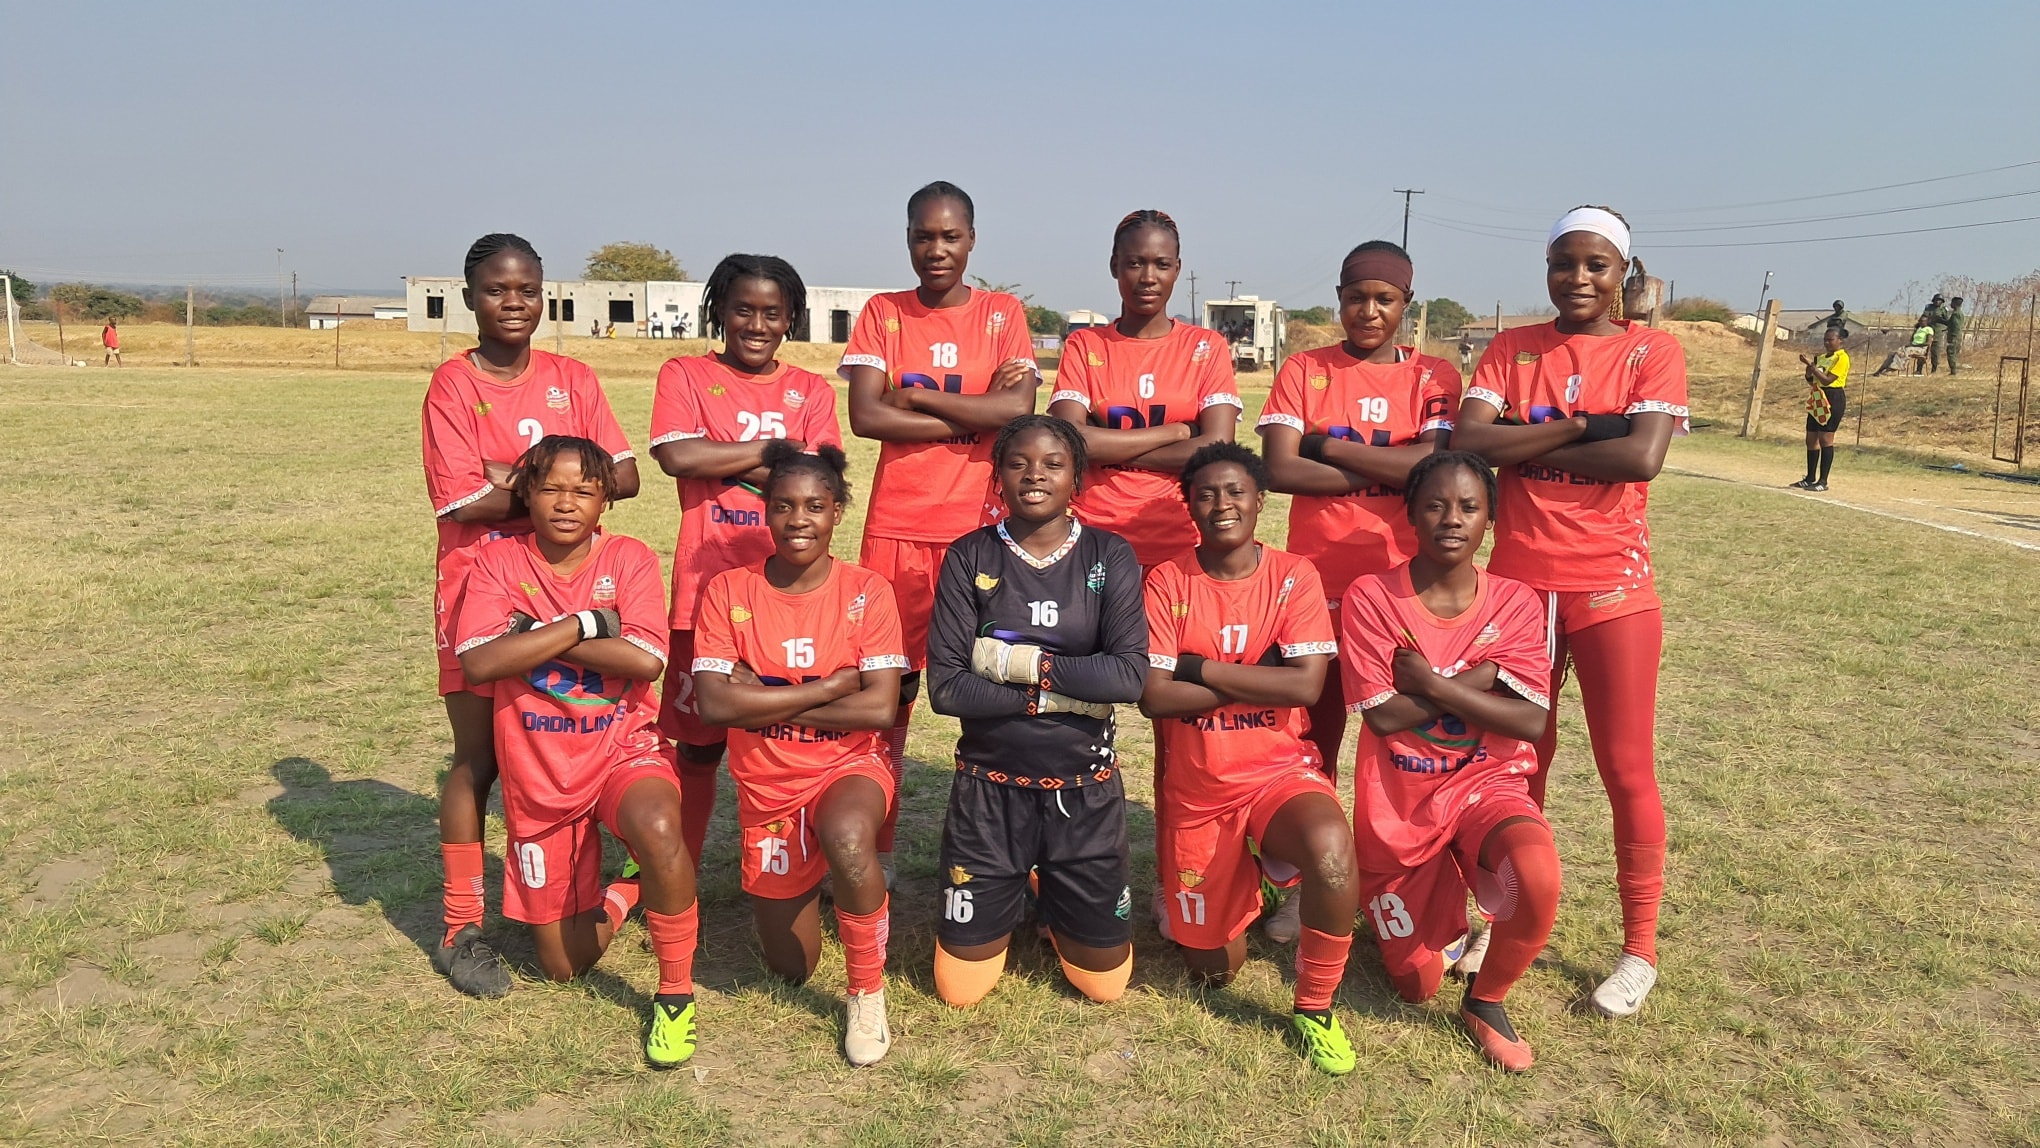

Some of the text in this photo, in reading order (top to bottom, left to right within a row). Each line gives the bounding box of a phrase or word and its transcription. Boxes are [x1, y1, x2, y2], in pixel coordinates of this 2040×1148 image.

[928, 341, 958, 369] 18
[1138, 372, 1155, 399] 6
[1564, 374, 1582, 404] 8
[1357, 396, 1389, 423] 19
[1425, 396, 1448, 419] C
[517, 417, 544, 449] 2
[736, 410, 787, 442] 25
[711, 504, 760, 527] DADA
[1027, 600, 1059, 628] 16
[781, 637, 816, 668] 15
[1219, 624, 1249, 654] 17
[674, 670, 700, 716] 2
[521, 705, 627, 734] DADA LINS
[1219, 709, 1276, 731] LINKS
[1390, 750, 1435, 774] ADA
[756, 836, 789, 876] 15
[943, 886, 974, 924] 16
[1175, 890, 1205, 926] 17
[1368, 892, 1414, 941] 13
